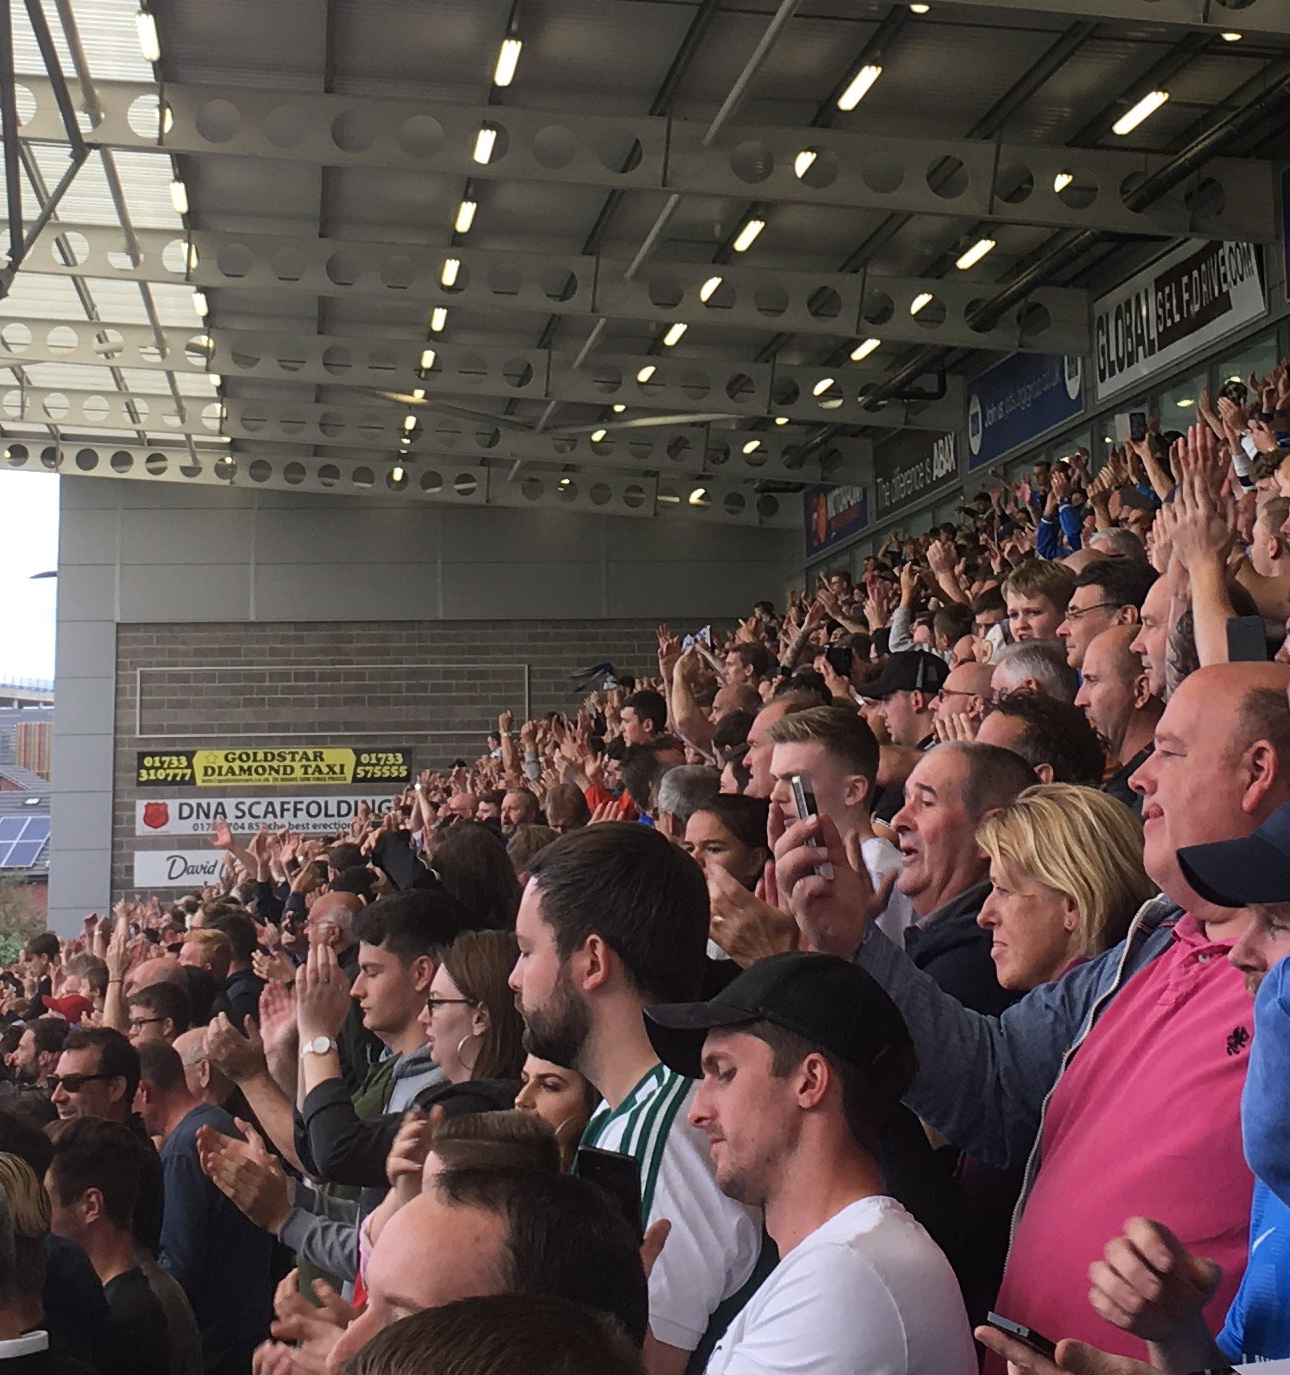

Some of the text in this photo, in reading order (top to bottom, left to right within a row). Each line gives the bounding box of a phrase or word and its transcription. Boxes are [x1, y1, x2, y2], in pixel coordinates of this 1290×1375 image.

[1096, 288, 1156, 384] GLOBAL
[932, 432, 956, 482] ABAX
[143, 756, 188, 768] 01733
[223, 751, 326, 763] GOLDSTAR
[360, 753, 403, 765] 01733
[139, 769, 192, 782] 310777
[203, 763, 346, 777] DIAMOND TAXI
[356, 766, 408, 778] 575555
[178, 801, 228, 821] DNA
[288, 820, 310, 830] best
[166, 854, 219, 881] David
